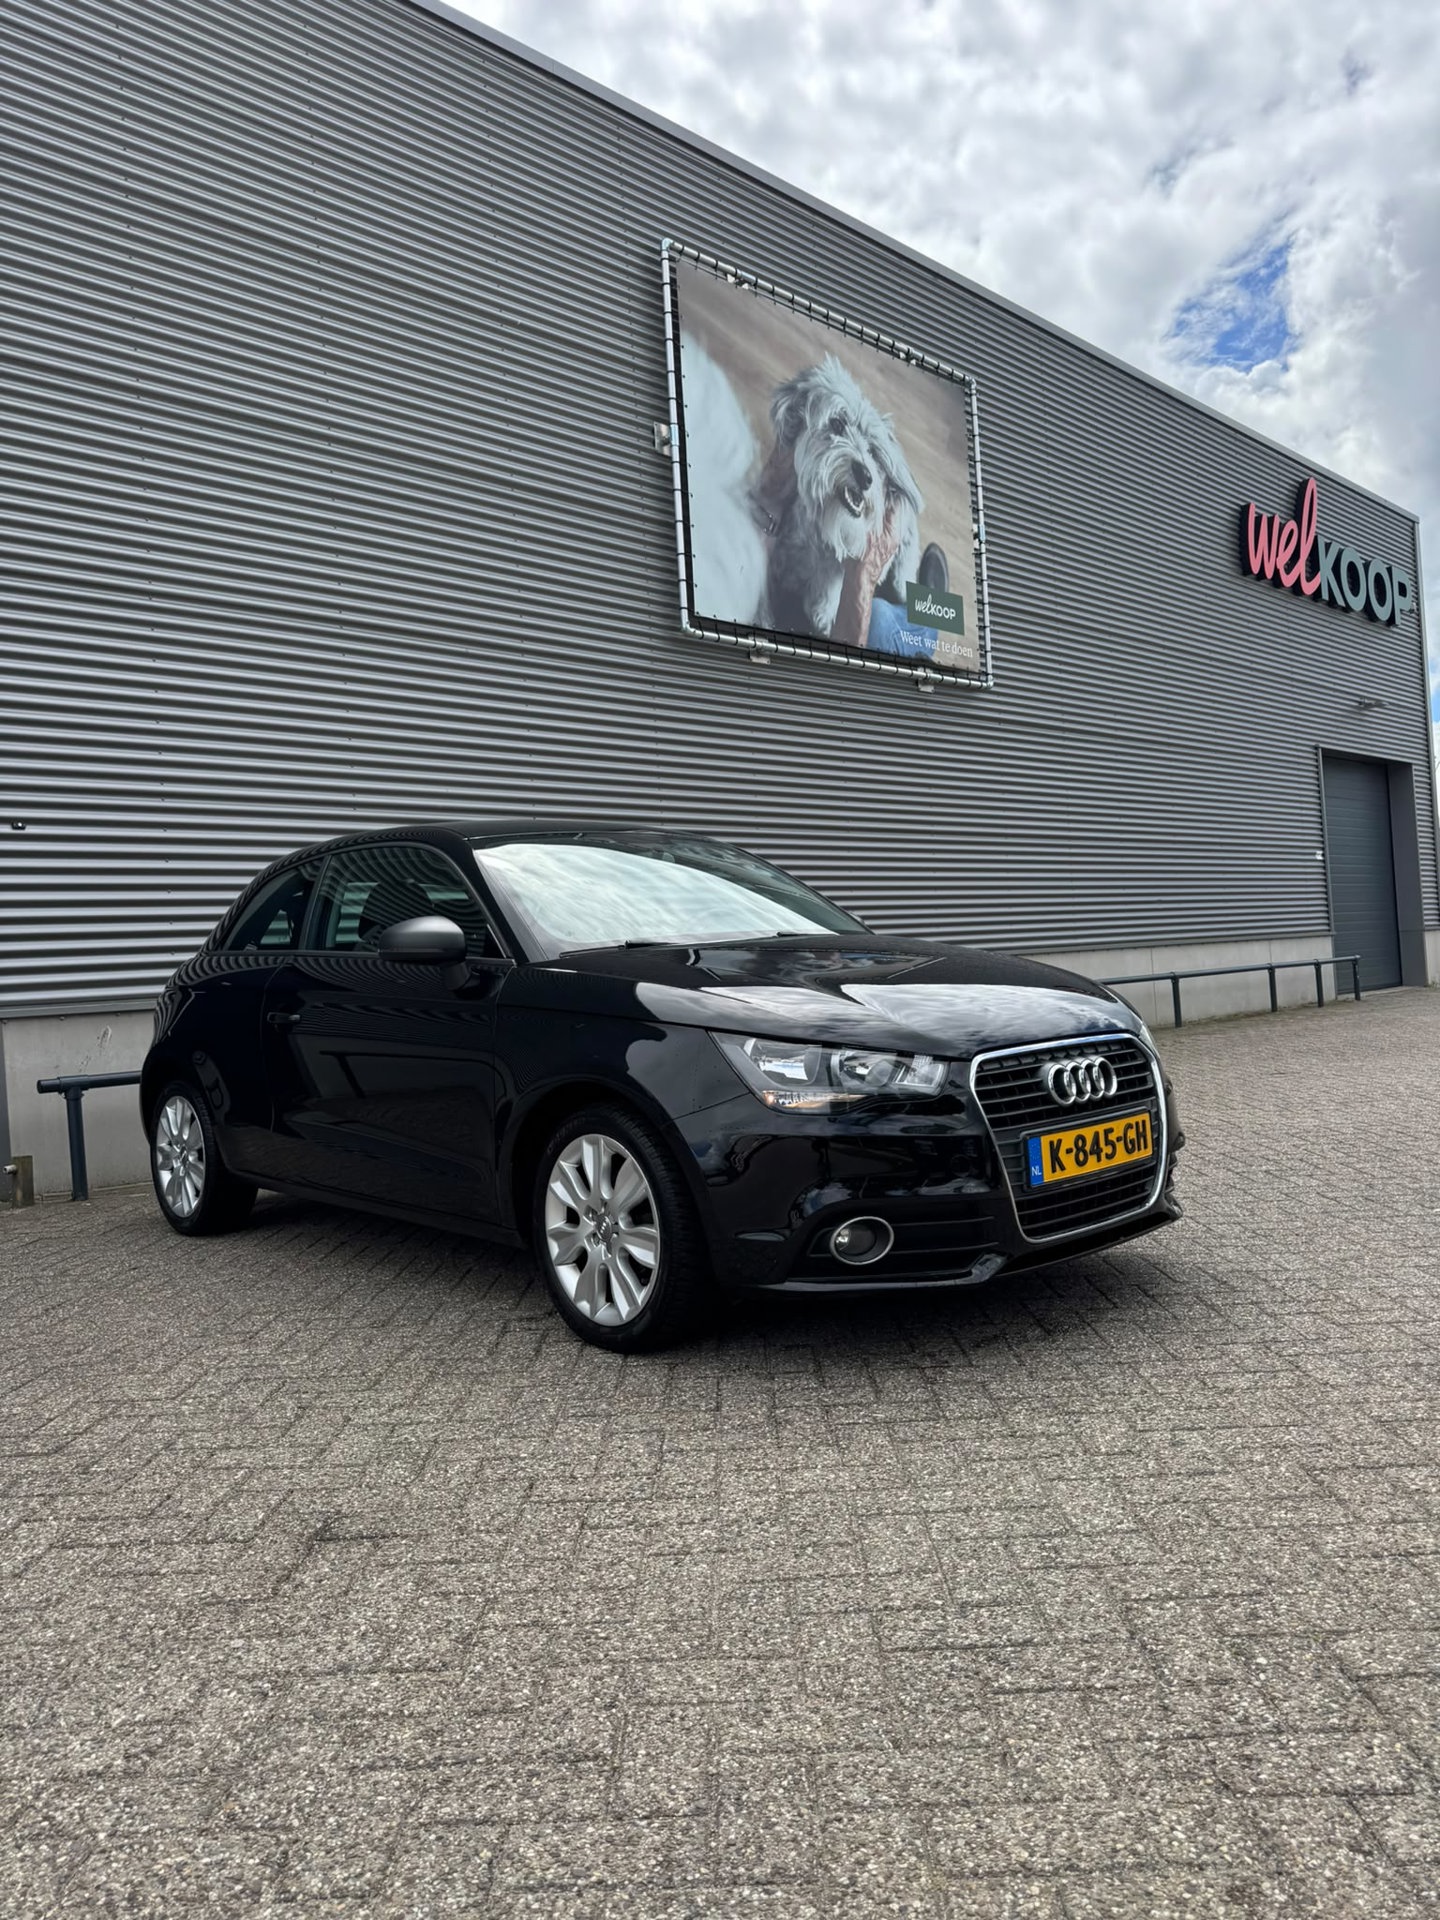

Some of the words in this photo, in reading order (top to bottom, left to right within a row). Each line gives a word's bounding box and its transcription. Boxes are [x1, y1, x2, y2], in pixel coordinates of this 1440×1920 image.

[900, 630, 922, 647] Weet
[924, 638, 940, 651] wat
[941, 641, 951, 654] te
[951, 642, 974, 658] doen
[1049, 1119, 1148, 1174] K-845-GH
[1031, 1166, 1043, 1176] NL
